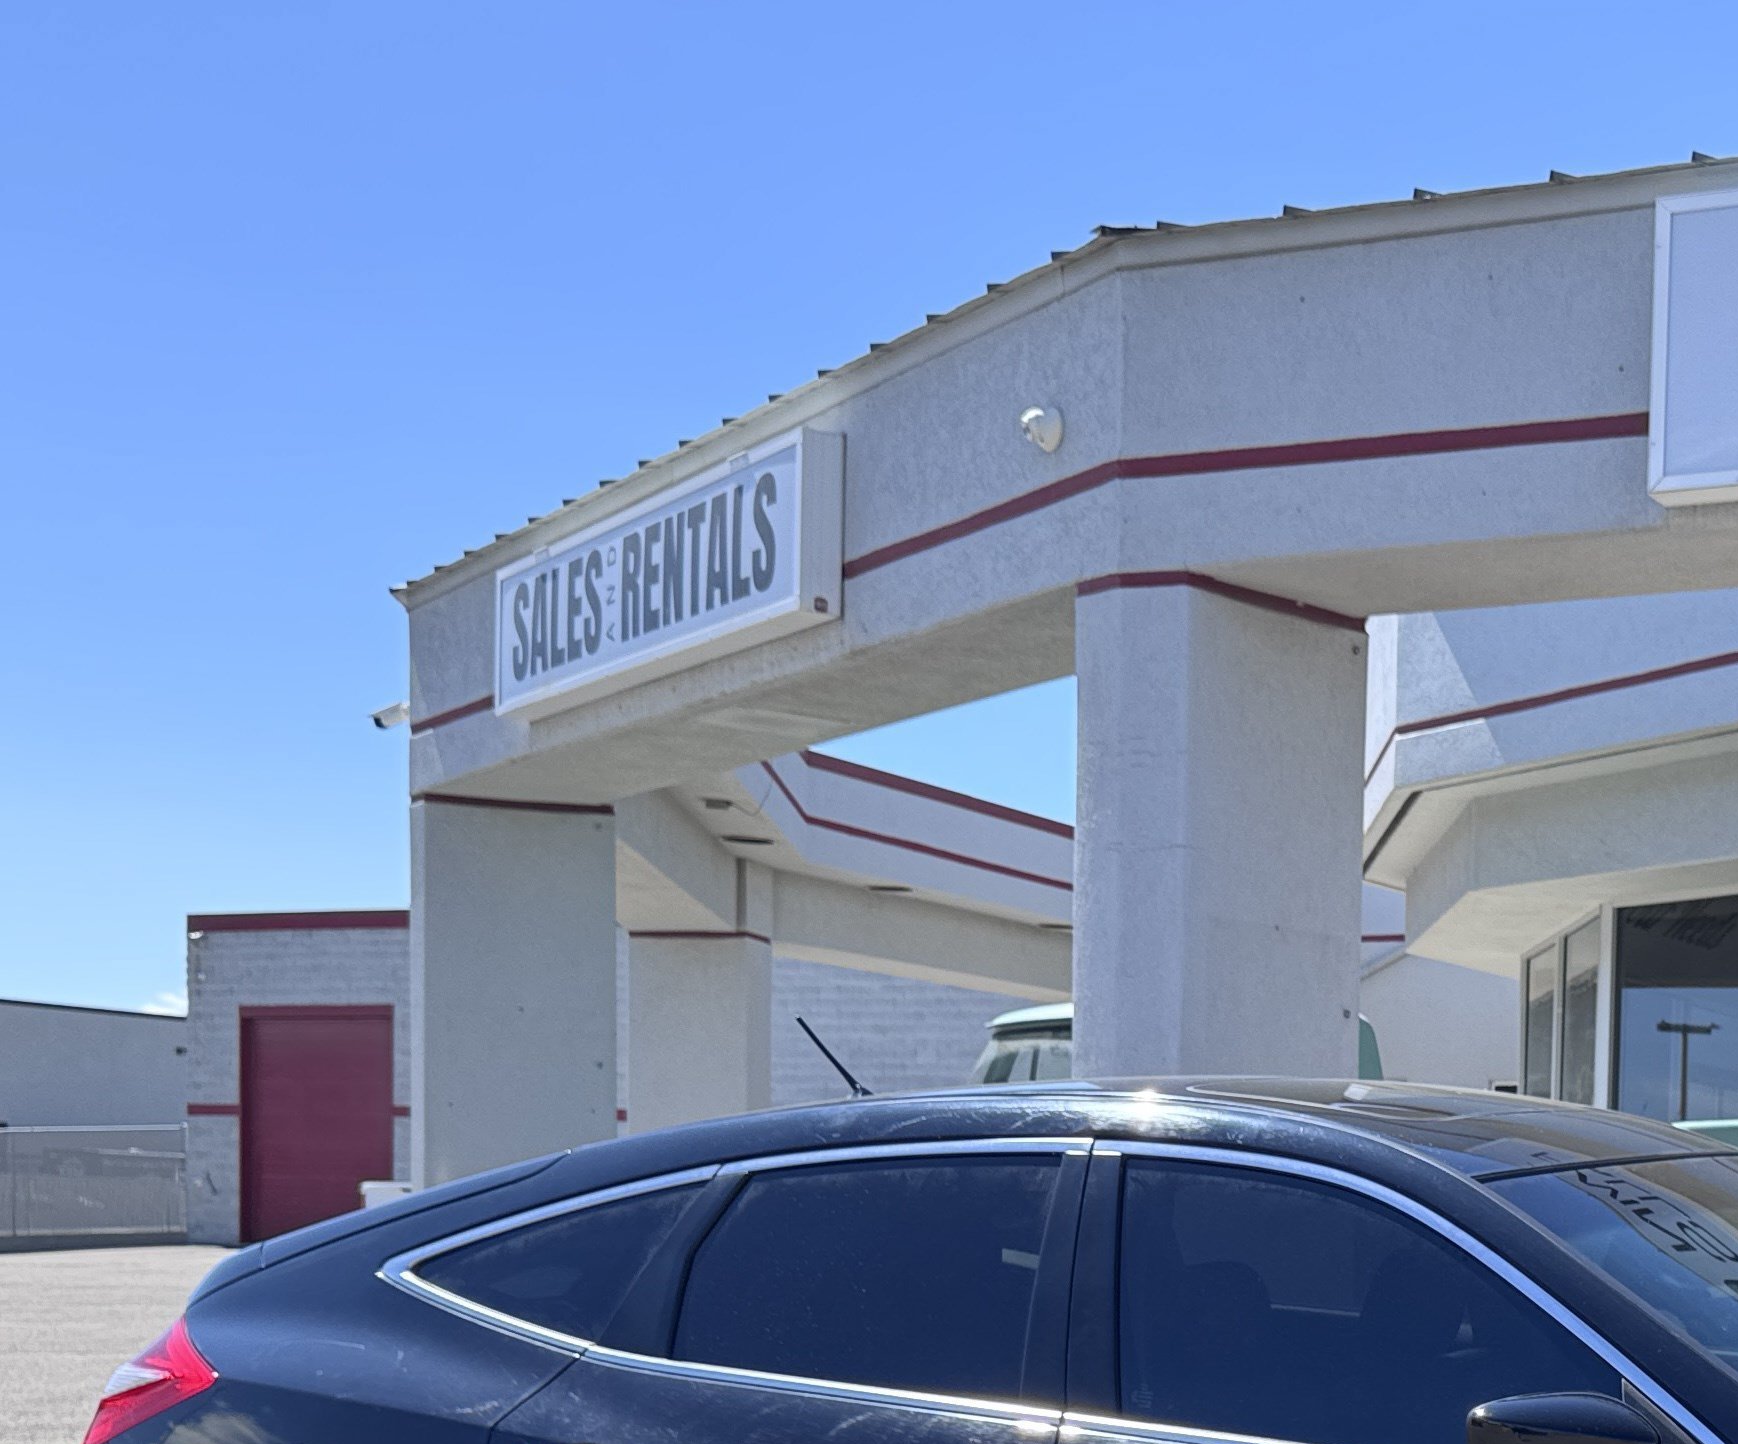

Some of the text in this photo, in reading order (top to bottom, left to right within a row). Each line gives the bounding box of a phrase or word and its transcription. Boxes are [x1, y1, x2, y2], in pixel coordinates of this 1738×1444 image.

[512, 471, 778, 682] SALES AND RENTALS
